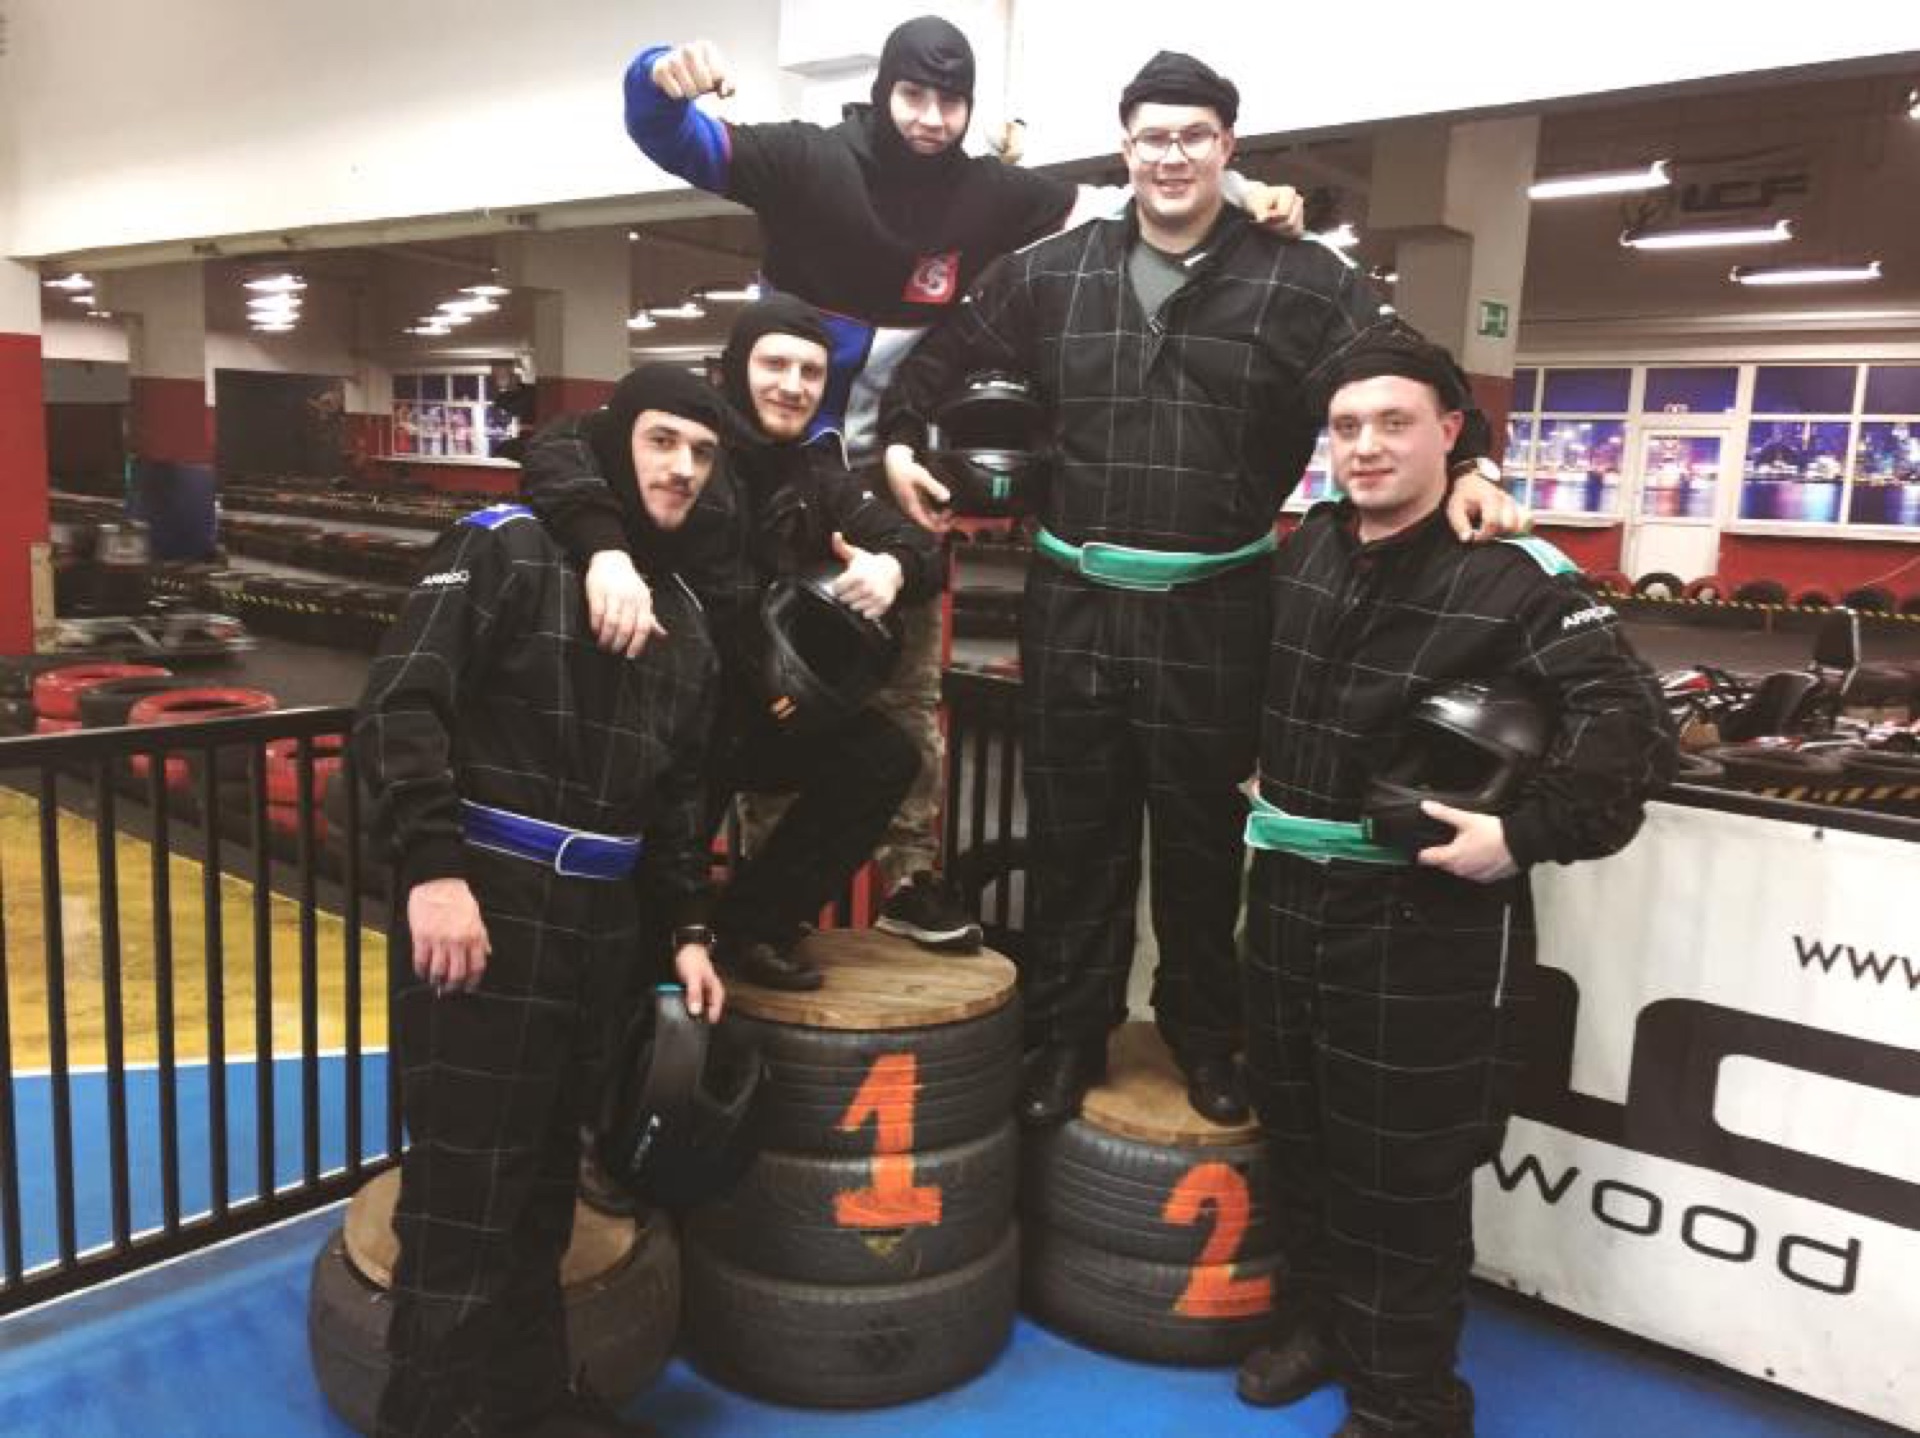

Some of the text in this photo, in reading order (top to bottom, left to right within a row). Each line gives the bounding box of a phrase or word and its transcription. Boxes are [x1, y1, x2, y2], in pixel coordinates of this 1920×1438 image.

[832, 1053, 942, 1228] 1
[1160, 1161, 1272, 1318] 2
[1492, 1152, 1861, 1296] wood
